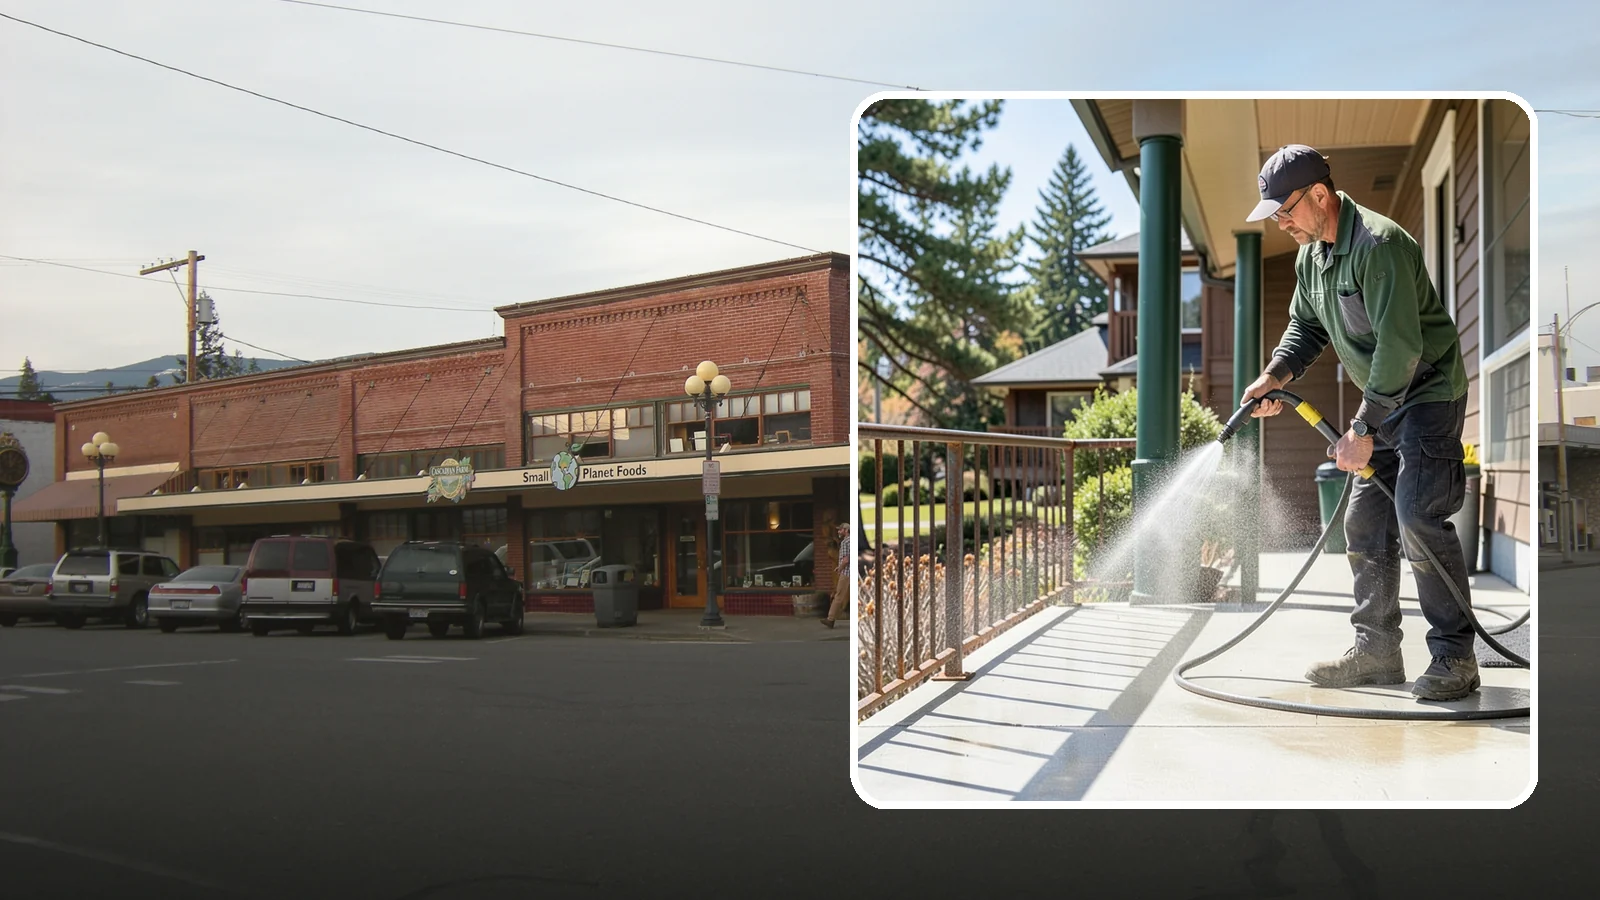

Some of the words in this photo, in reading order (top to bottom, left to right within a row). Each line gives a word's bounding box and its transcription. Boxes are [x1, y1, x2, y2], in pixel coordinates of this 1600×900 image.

[523, 471, 549, 482] Small
[583, 468, 614, 479] Planet
[617, 465, 647, 476] Foods
